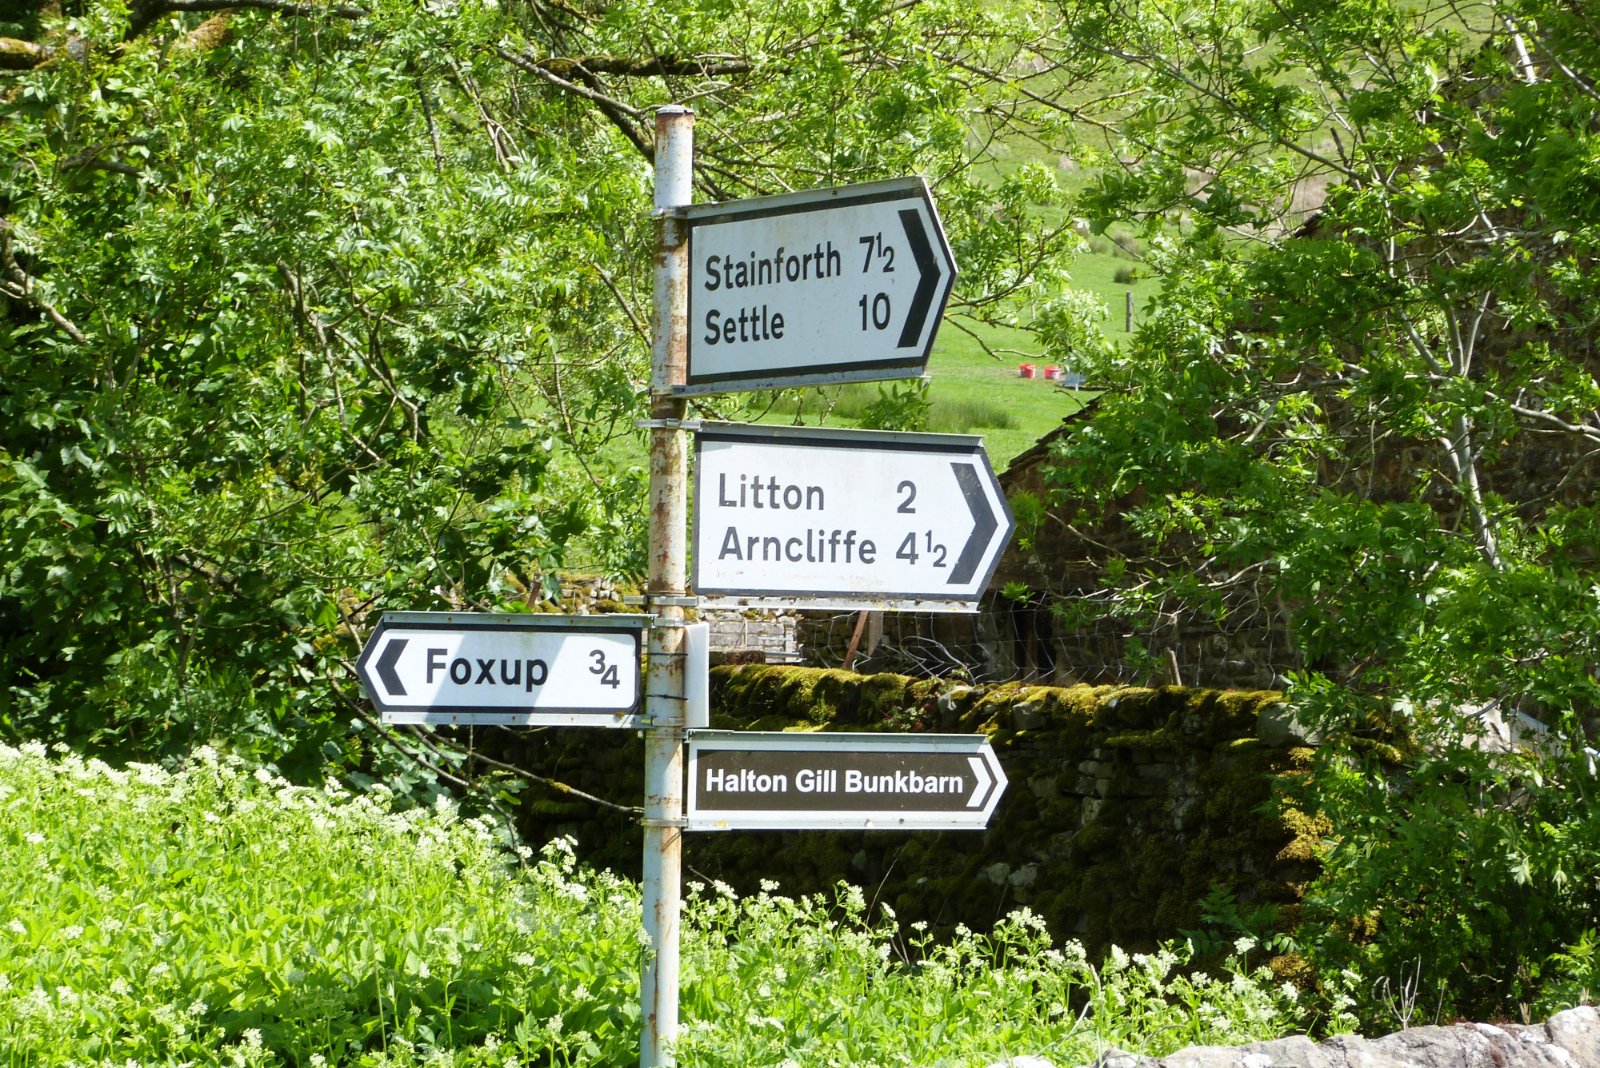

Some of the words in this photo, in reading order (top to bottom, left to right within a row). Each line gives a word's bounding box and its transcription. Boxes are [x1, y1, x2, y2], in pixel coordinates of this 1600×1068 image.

[704, 241, 841, 291] Stainforth
[704, 304, 785, 345] Settle
[859, 292, 891, 331] 10
[718, 472, 825, 511] Litton
[896, 480, 917, 514] 2
[718, 526, 877, 565] Arncliffe
[426, 647, 549, 693] Foxup
[705, 768, 788, 793] Halton
[795, 768, 838, 794] Gill
[844, 768, 965, 794] Bunkbarn
